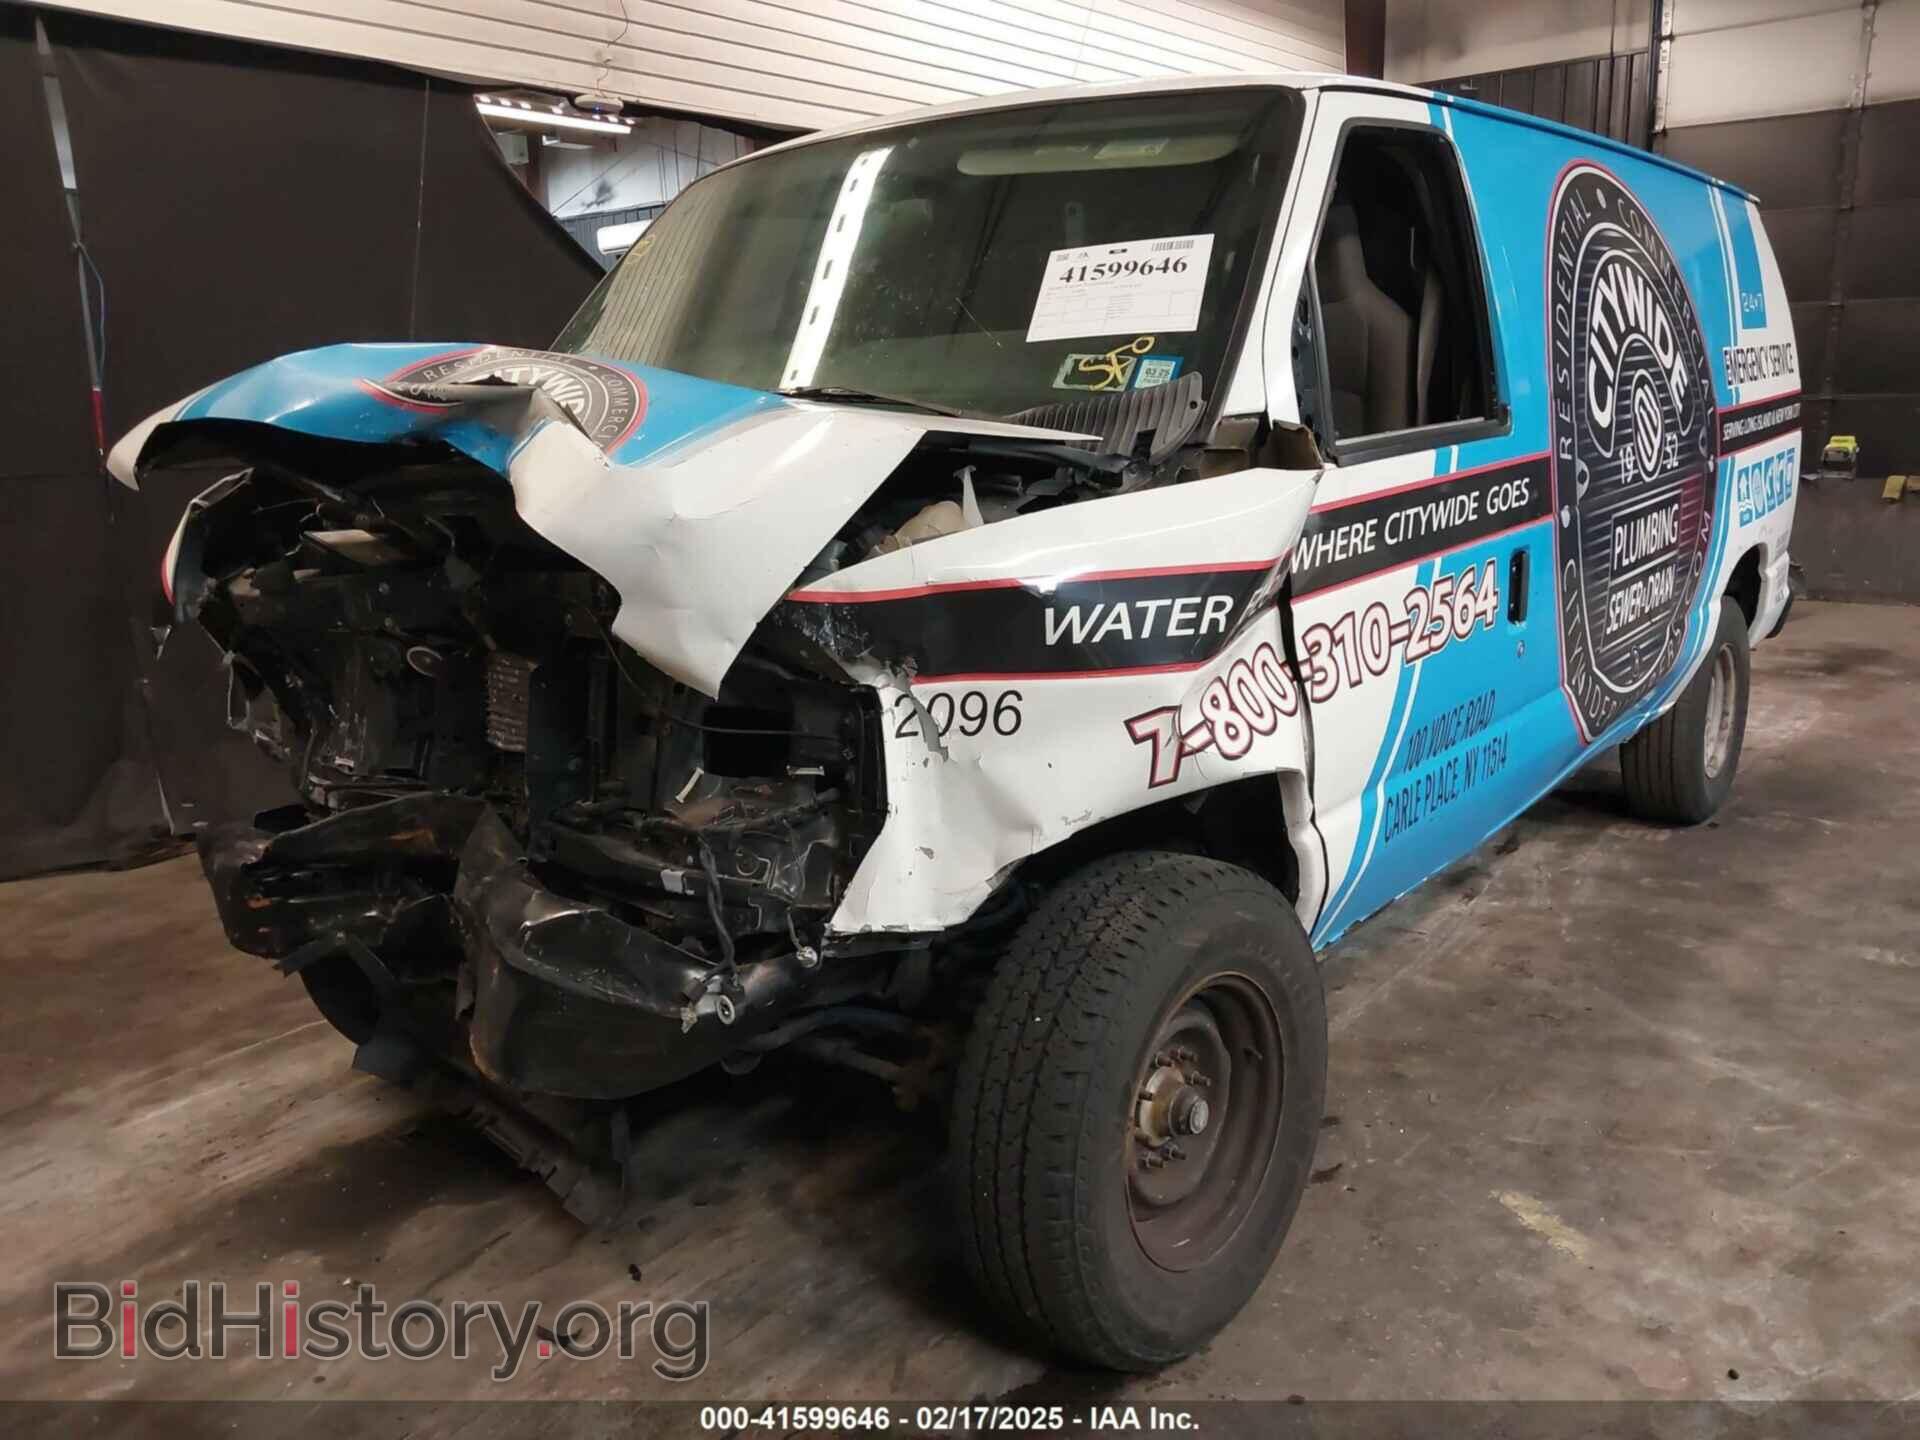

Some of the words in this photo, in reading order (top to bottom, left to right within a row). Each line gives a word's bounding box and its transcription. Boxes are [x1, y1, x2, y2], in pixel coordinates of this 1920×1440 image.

[1059, 256, 1188, 283] 41599646
[1556, 189, 1592, 460] RESIDENTIAL
[1617, 198, 1713, 422] COMMERCIAL
[1588, 262, 1689, 428] CITYWIDE
[1724, 345, 1769, 386] EMERGENCY
[1769, 342, 1794, 377] SERVICE
[593, 373, 630, 447] COMMERCI
[1290, 518, 1378, 574] WHERE
[1384, 491, 1480, 546] CITYWIDE
[1486, 478, 1531, 514] GOES
[1613, 503, 1679, 571] PLUMBING
[1044, 595, 1234, 647] WATER
[894, 689, 1024, 740] 2096
[1461, 688, 1496, 741] ROAD
[1384, 779, 1422, 844] CARLE
